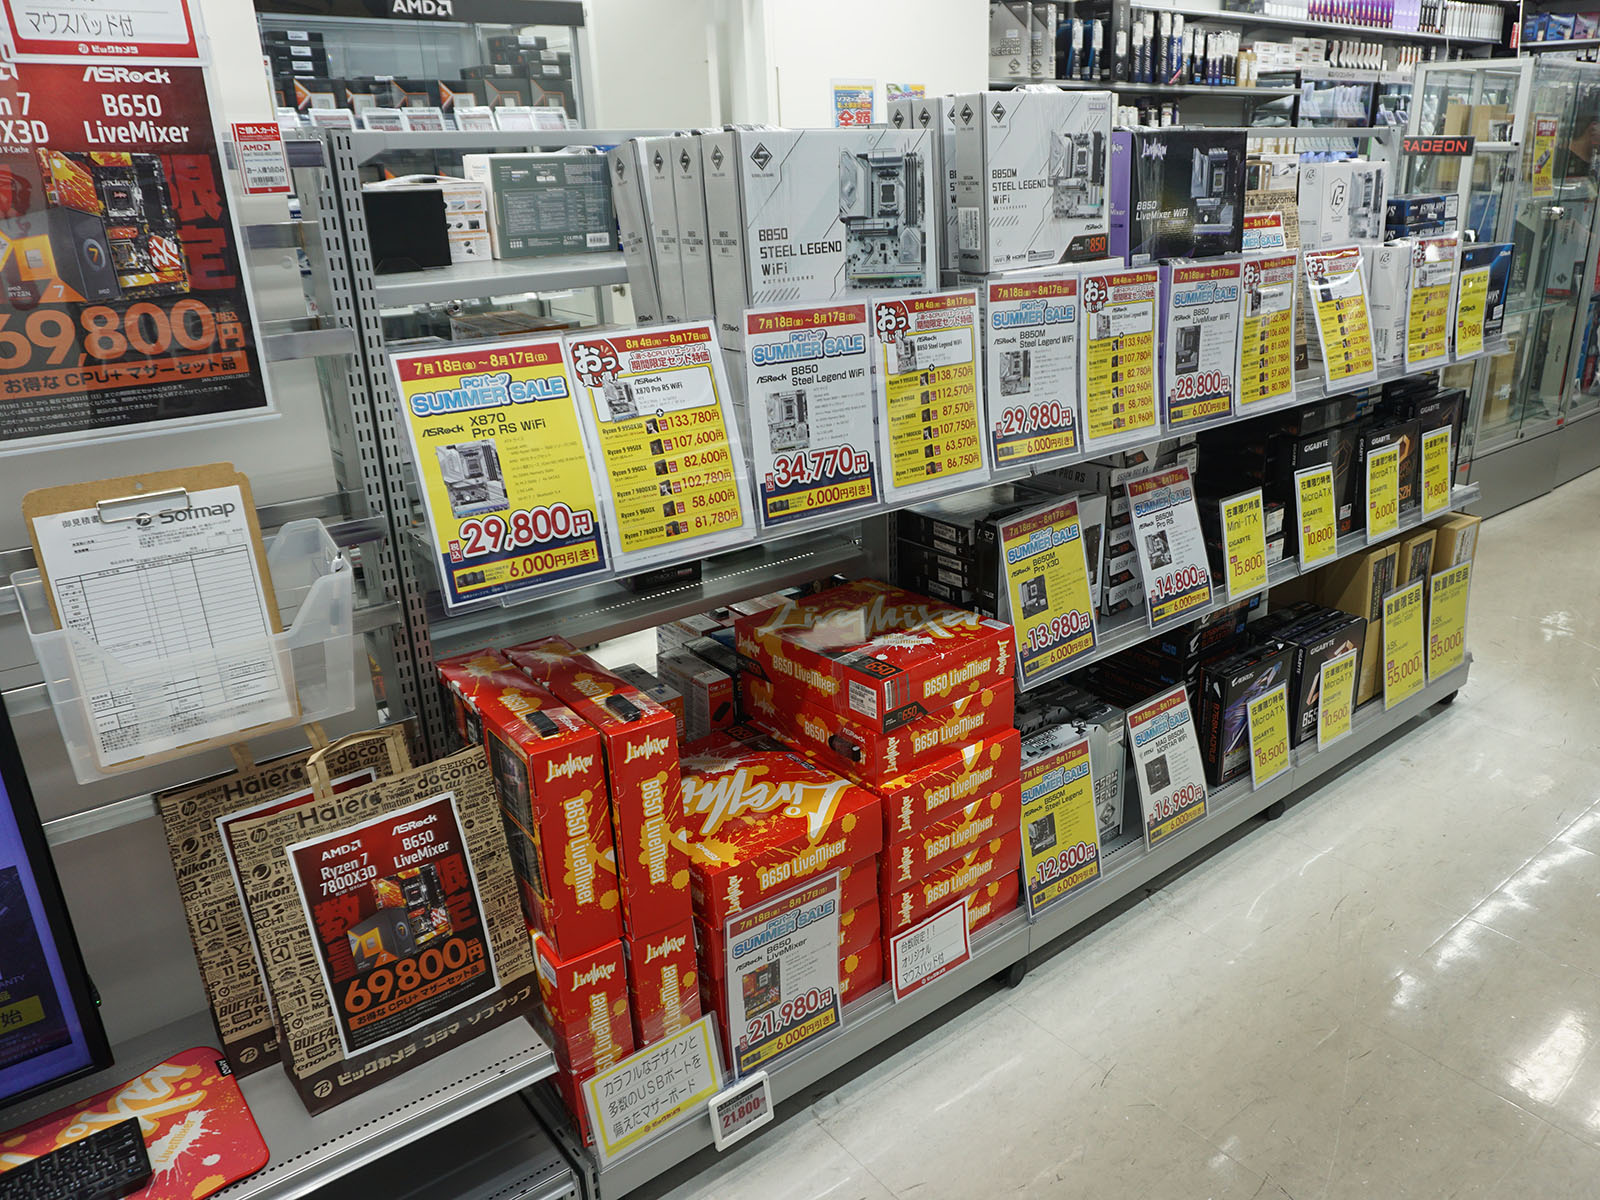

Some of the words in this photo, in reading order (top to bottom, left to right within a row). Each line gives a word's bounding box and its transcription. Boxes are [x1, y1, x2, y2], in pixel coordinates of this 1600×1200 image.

[393, 1, 436, 14] AMD
[25, 11, 135, 38] マウスパッド付
[83, 66, 172, 84] ASRock
[102, 93, 162, 117] B650
[84, 121, 190, 144] LiveMixer
[1403, 140, 1467, 152] RADEON
[992, 169, 1017, 179] B850M
[992, 182, 1016, 191] STEEL
[1018, 179, 1047, 189] LEGEND
[993, 195, 1010, 204] WiFi
[1137, 201, 1156, 210] B850
[1136, 210, 1171, 221] LiveMixer
[759, 227, 788, 241] B850
[760, 244, 797, 258] STEEL
[800, 240, 842, 256] LEGEND
[762, 263, 787, 275] WiFi
[1175, 290, 1212, 305] SUMMER
[1214, 287, 1237, 299] SALE
[993, 310, 1042, 327] SUMMER
[1045, 307, 1073, 322] SALE
[1020, 330, 1046, 339] B850M
[1020, 340, 1037, 348] Steel
[1038, 337, 1060, 346] Legend
[575, 344, 617, 373] おっ
[754, 342, 821, 363] SUMMER
[825, 336, 864, 354] SALE
[757, 374, 787, 384] ASRock
[791, 364, 818, 375] B850
[792, 375, 814, 386] Steel
[816, 370, 847, 383] Legend
[849, 368, 865, 379] WiFi
[4, 376, 59, 394] お得な
[462, 374, 508, 389] PCパーツ
[634, 376, 662, 385] ASRock
[1177, 372, 1229, 399] 28,800円
[412, 387, 509, 413] SUMMER
[511, 377, 565, 400] SALE
[469, 413, 506, 427] X870
[472, 426, 495, 438] Pro
[500, 423, 517, 434] RS
[521, 418, 546, 431] WiFi
[669, 410, 719, 428] 133,780円
[1003, 403, 1071, 434] 29,980円
[422, 425, 464, 437] ASRock
[673, 431, 724, 448] 107,600円
[1371, 433, 1391, 445] GIGABYTE
[1304, 439, 1329, 452] GIGABYTE
[684, 450, 728, 467] 82,600円
[775, 447, 868, 485] 34,770円
[692, 491, 735, 508] 58,600円
[1135, 497, 1170, 516] SUMMER
[1170, 487, 1191, 503] SALE
[1226, 499, 1260, 519] 在庫限り特価
[160, 502, 235, 524] Sofmap
[695, 510, 738, 528] 81,780円
[1227, 511, 1258, 531] Mini-ITX
[463, 505, 590, 555] 29,800円
[1008, 537, 1051, 563] SUMMER
[1053, 525, 1078, 544] SALE
[1228, 535, 1250, 547] GIGABYTE
[1033, 552, 1056, 567] B650M
[1034, 564, 1045, 574] Pro
[1156, 566, 1207, 597] 14,800円
[1028, 611, 1090, 651] 13,980円
[1311, 638, 1335, 655] GIGABYTE
[772, 655, 794, 677] B650
[794, 661, 837, 694] LiveMixer
[924, 679, 949, 698] B650
[949, 657, 992, 687] LiveMixer
[804, 719, 825, 743] B650
[914, 732, 939, 753] B650
[940, 712, 985, 742] LiveMixer
[1136, 723, 1168, 745] SUMMER
[1170, 710, 1188, 727] SALE
[417, 759, 487, 789] docomo
[439, 757, 473, 771] SEIKO
[926, 790, 950, 811] B650
[951, 766, 994, 801] LiveMixer
[1022, 776, 1062, 803] SUMMER
[1064, 763, 1089, 784] SALE
[642, 779, 662, 816] B650
[1061, 788, 1083, 806] Legend
[1155, 784, 1203, 821] 16,980円
[392, 814, 438, 837] ASRock
[564, 798, 587, 836] B650
[402, 829, 434, 851] B650
[926, 839, 950, 860] B650
[950, 814, 994, 850] LiveMixer
[321, 846, 350, 862] AMD
[393, 841, 450, 869] LiveMixer
[645, 817, 666, 885] LiveMixer
[177, 858, 217, 879] Nikon
[320, 859, 359, 881] Ryzen
[362, 852, 369, 866] 7
[569, 836, 594, 905] LiveMixer
[761, 864, 790, 891] B650
[793, 838, 847, 875] LiveMixer
[1037, 843, 1095, 883] 12,800円
[320, 865, 377, 897] 7800X3D
[925, 883, 950, 905] B650
[950, 858, 993, 894] LiveMixer
[249, 886, 290, 905] Nikon
[735, 920, 794, 955] SUMMER
[798, 902, 833, 929] SALE
[766, 939, 791, 953] B650
[766, 940, 807, 962] LiveMixer
[735, 956, 763, 972] ASRock
[344, 937, 484, 1014] 69,800円
[749, 990, 831, 1045] 21,980円
[338, 1043, 417, 1087] ビックカメラ
[423, 1024, 460, 1049] コジマ
[467, 985, 531, 1026] ソフマップ
[603, 1035, 698, 1098] カラフルなデザインと
[612, 1078, 696, 1138] 備えたマザーボード
